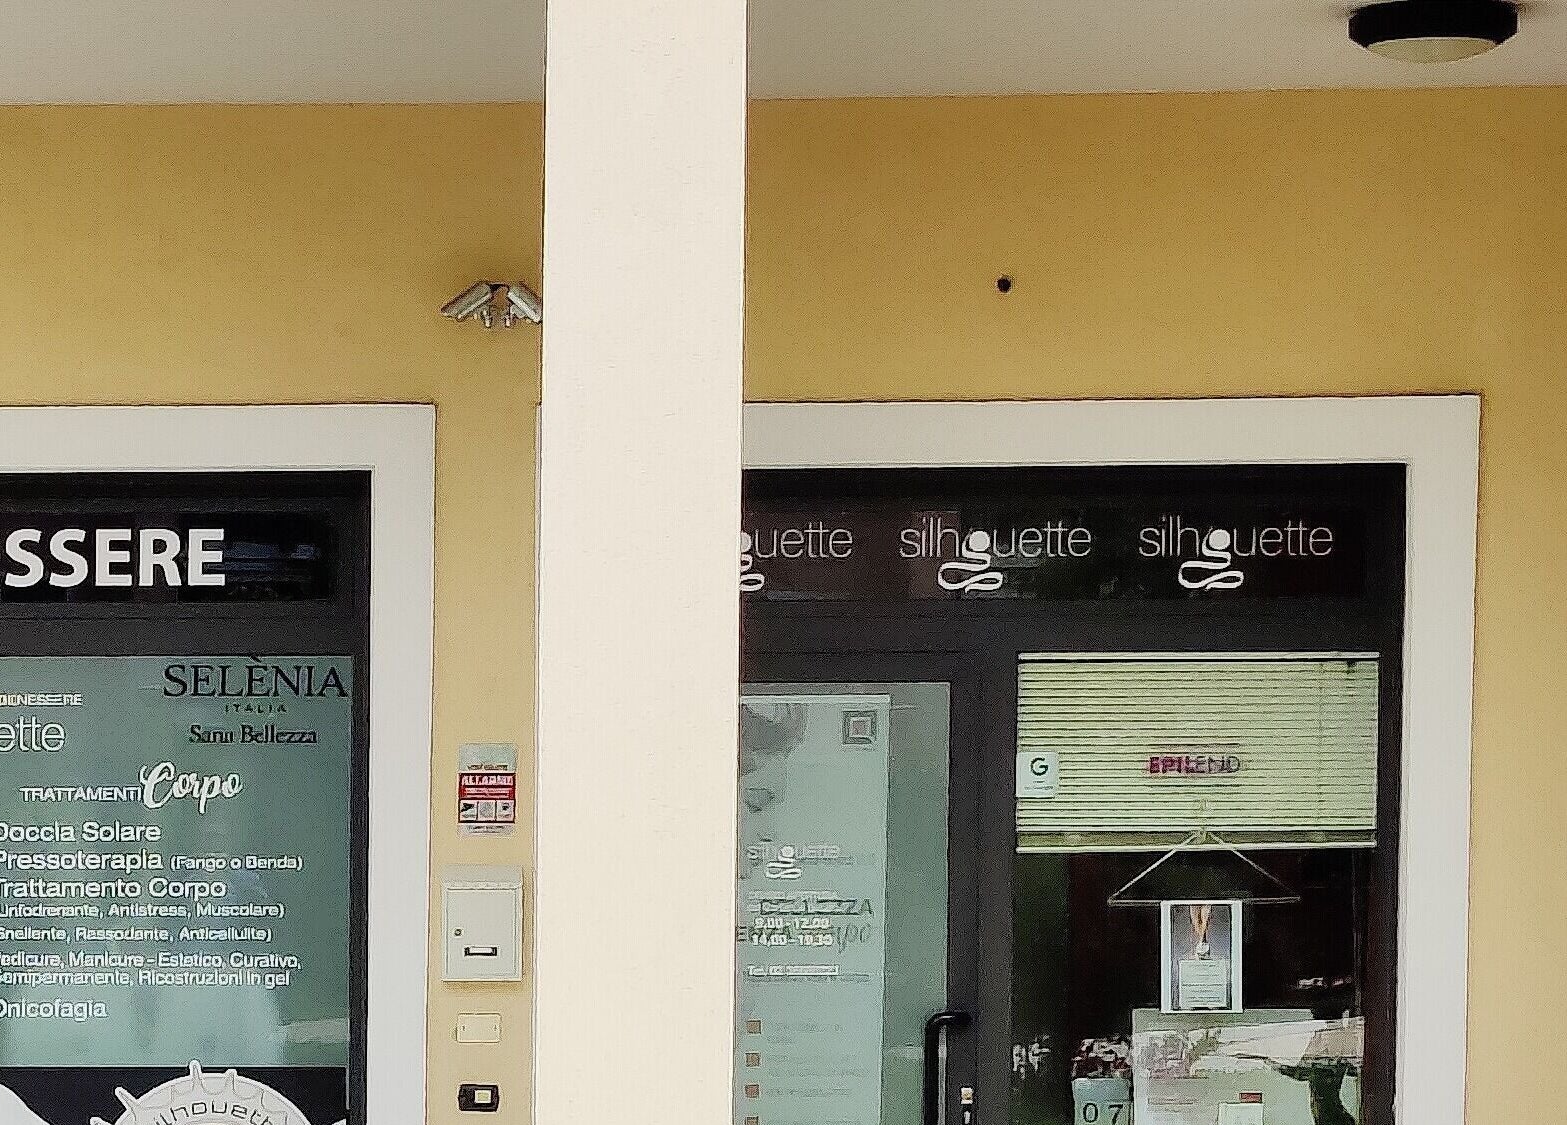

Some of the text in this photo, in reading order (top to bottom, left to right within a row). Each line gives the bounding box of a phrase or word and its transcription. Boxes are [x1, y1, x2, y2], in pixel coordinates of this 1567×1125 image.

[163, 655, 348, 697] SELÈNIA
[225, 704, 287, 713] ITALIA
[240, 725, 317, 743] Bellezza
[1031, 757, 1049, 776] G
[20, 761, 244, 815] TRATTAMENTI Corpo
[81, 820, 162, 842] Solare
[170, 855, 227, 872] (Fango
[230, 858, 241, 870] o
[148, 876, 227, 902] Corpo
[108, 902, 192, 918] Antistress,
[197, 902, 285, 918] Muscolare)
[68, 951, 144, 968] Manicure
[138, 968, 243, 985] Ricostruzioni
[246, 969, 259, 984] in
[265, 970, 290, 989] gel
